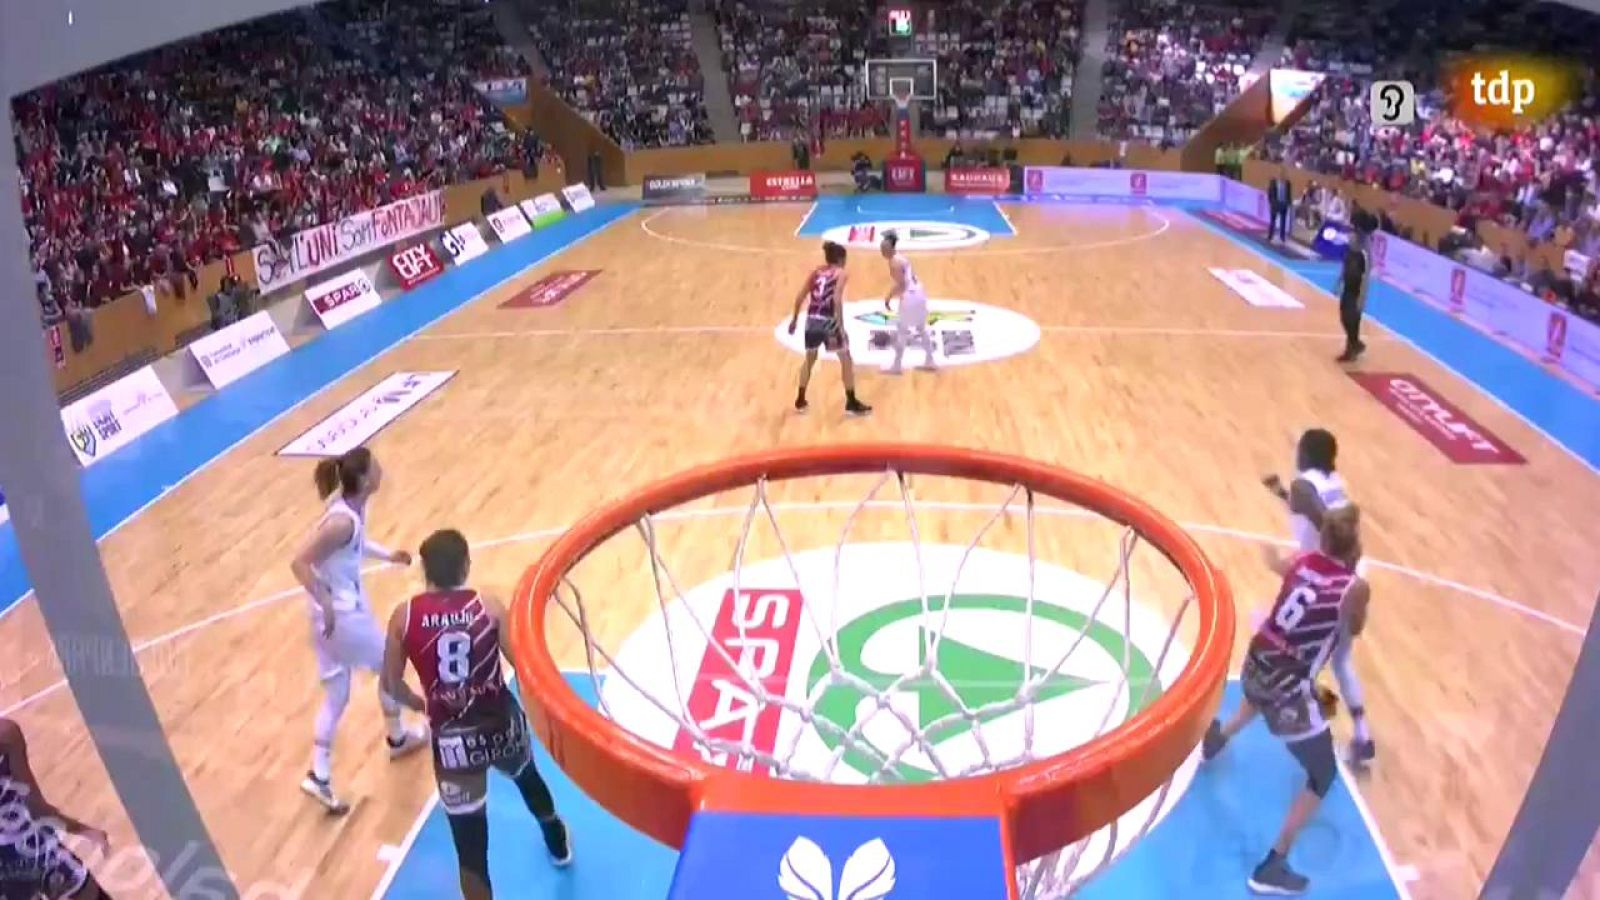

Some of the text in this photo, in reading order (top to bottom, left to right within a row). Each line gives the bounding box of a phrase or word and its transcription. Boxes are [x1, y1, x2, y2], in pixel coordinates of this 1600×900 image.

[325, 284, 360, 307] SPAR
[421, 611, 475, 629] ARAUJO
[1275, 585, 1317, 631] 6
[436, 630, 471, 684] 8
